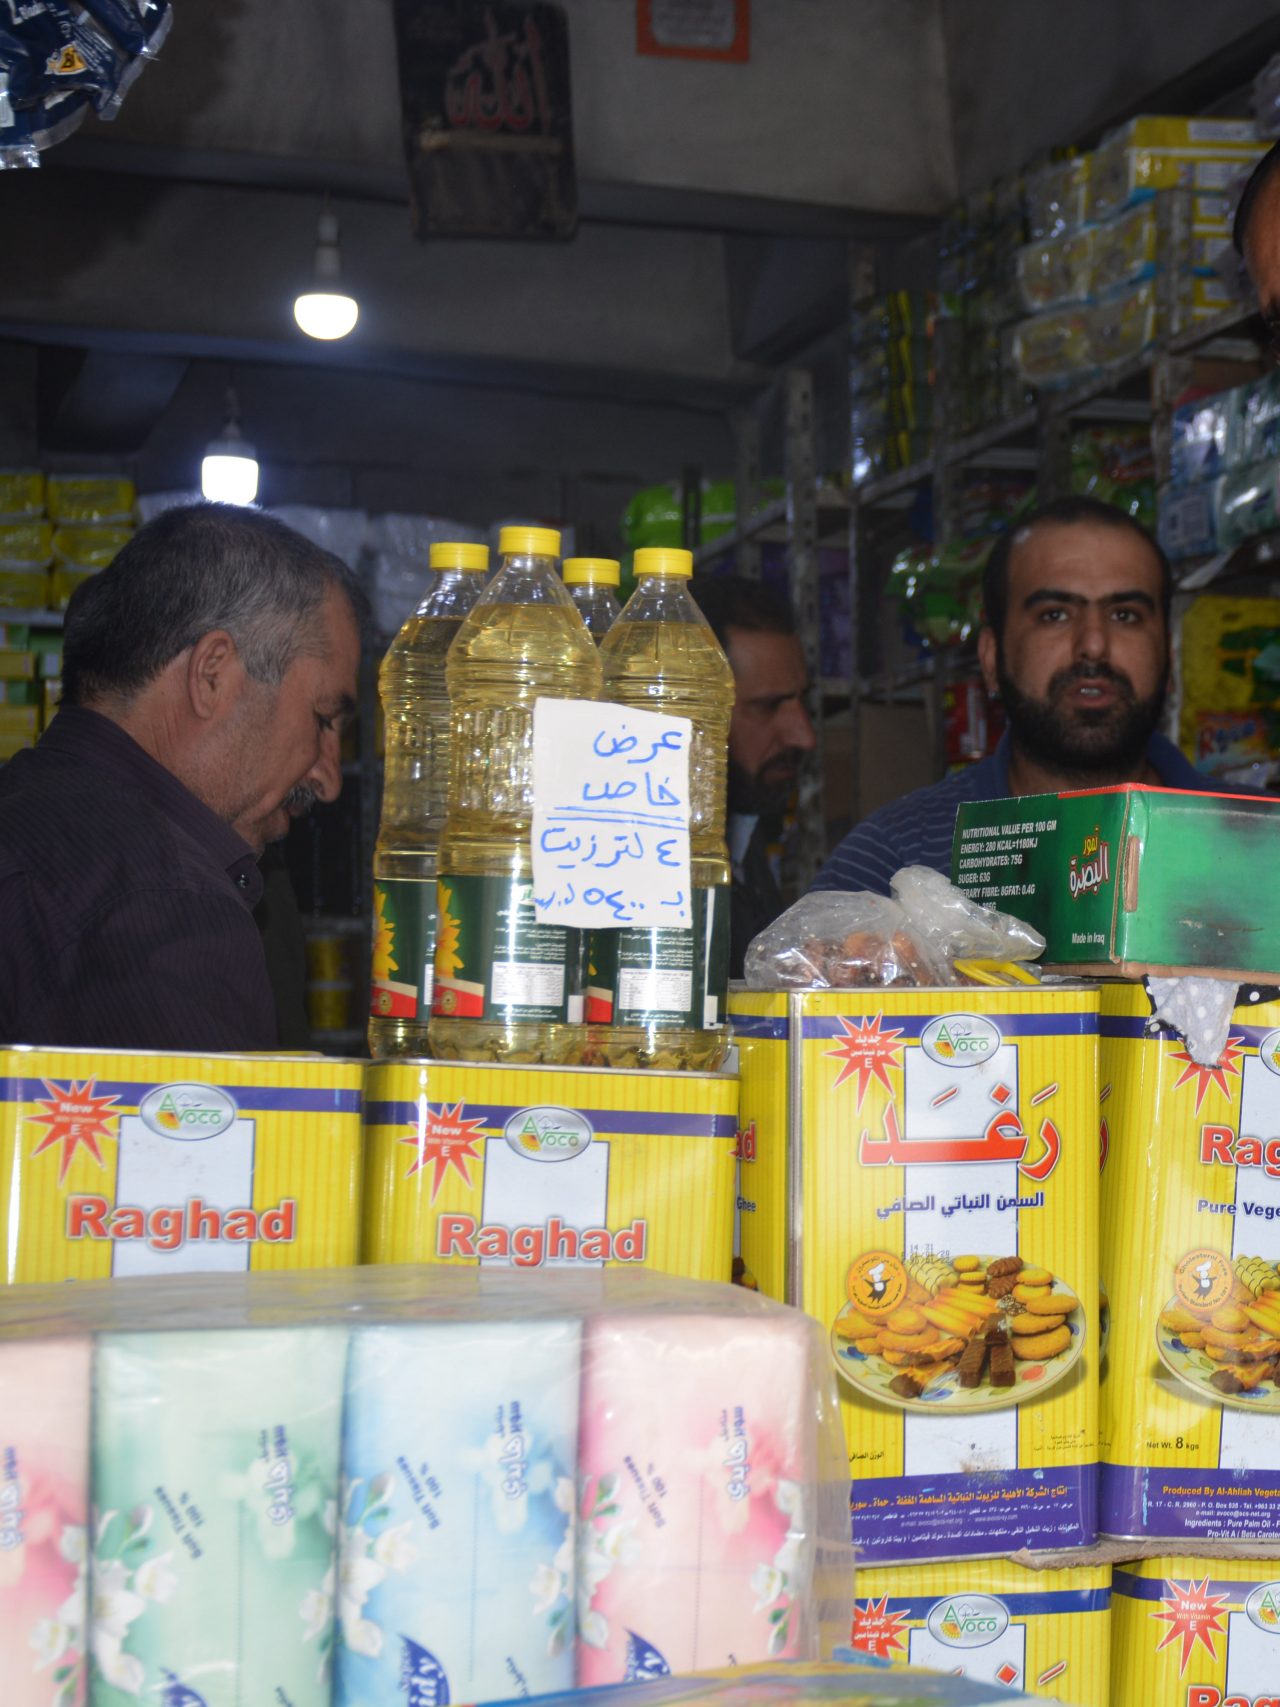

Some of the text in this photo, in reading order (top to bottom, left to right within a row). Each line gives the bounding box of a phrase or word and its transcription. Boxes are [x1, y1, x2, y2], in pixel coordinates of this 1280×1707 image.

[593, 725, 683, 764] عرض
[582, 772, 682, 807] خاص
[962, 820, 1057, 839] NUTRITIONAL VALUE PER 100 GM
[960, 843, 985, 855] ENERGY:
[985, 841, 997, 852] 280
[1070, 842, 1110, 899] البصرة
[1071, 932, 1105, 945] Made in Iraq
[60, 1102, 93, 1114] New
[431, 1125, 462, 1136] New
[941, 1193, 990, 1217] النباتي
[996, 1192, 1045, 1208] السمن
[1197, 1199, 1238, 1215] Pure
[66, 1194, 296, 1252] Raghad
[437, 1214, 647, 1268] Raghad
[1146, 1441, 1162, 1450] Net
[1175, 1437, 1184, 1449] 8
[1185, 1441, 1200, 1452] kgs
[1162, 1485, 1201, 1496] Produced
[1204, 1487, 1214, 1497] By
[1216, 1487, 1252, 1497] Al-Ahliah
[1184, 1518, 1222, 1528] Ingredients
[1227, 1519, 1242, 1527] Pure
[1243, 1519, 1261, 1527] Palm
[1261, 1519, 1271, 1528] Oil
[1180, 1600, 1207, 1611] New
